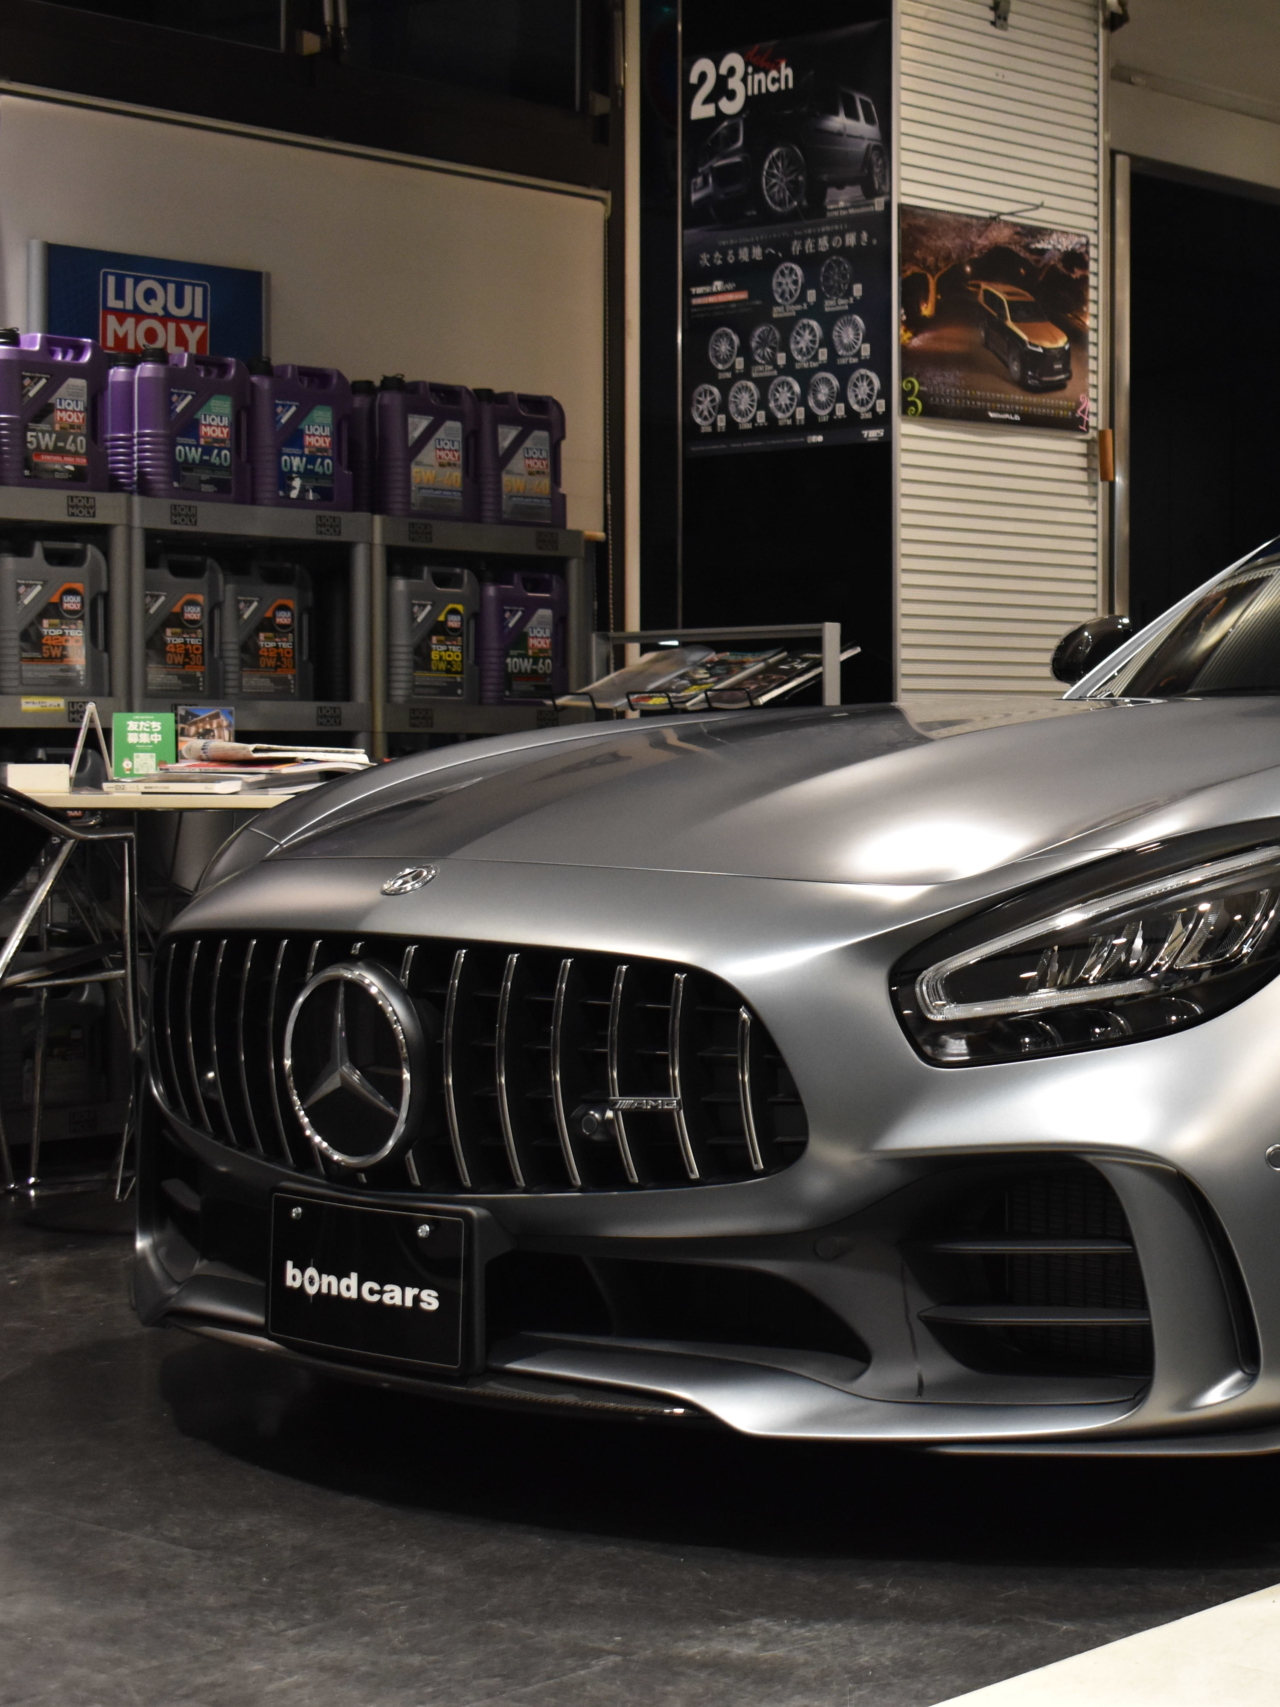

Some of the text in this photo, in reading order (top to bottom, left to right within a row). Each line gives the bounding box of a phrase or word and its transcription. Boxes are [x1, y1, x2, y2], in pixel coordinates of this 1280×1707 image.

[107, 275, 203, 318] LIQUI
[107, 315, 206, 354] MOLY
[902, 376, 922, 417] 3
[56, 399, 84, 411] LIQUI
[57, 411, 85, 423] MOLY
[201, 415, 229, 426] LIQUI
[202, 426, 229, 438] MOLY
[305, 425, 331, 436] LIQUI
[27, 432, 86, 453] 5W-40
[306, 436, 331, 447] MOLY
[436, 439, 460, 450] LIQUI
[176, 446, 230, 466] 0W-40
[437, 450, 460, 462] MOLY
[524, 448, 547, 459] LIQUI
[281, 456, 333, 475] 0W-40
[525, 459, 548, 470] MOLY
[412, 468, 462, 488] 5W-40
[504, 476, 550, 495] 5W-40
[69, 497, 95, 507] LIQUI
[69, 507, 95, 517] MOLY
[171, 505, 197, 515] LIQUI
[171, 515, 197, 526] MOLY
[529, 628, 550, 638] LIQUI
[42, 636, 83, 645] 4200
[529, 638, 551, 647] MOLY
[166, 645, 203, 653] 4210
[259, 648, 293, 657] 4210
[166, 654, 202, 665] 0W-30
[260, 657, 293, 667] 0W-30
[431, 652, 462, 661] 6100
[432, 661, 462, 671] 0W-30
[506, 657, 552, 673] 10W-60
[126, 721, 162, 732] 友だち
[127, 733, 162, 744] 募集中
[634, 1100, 677, 1109] AMG
[285, 1259, 440, 1311] bond cars
